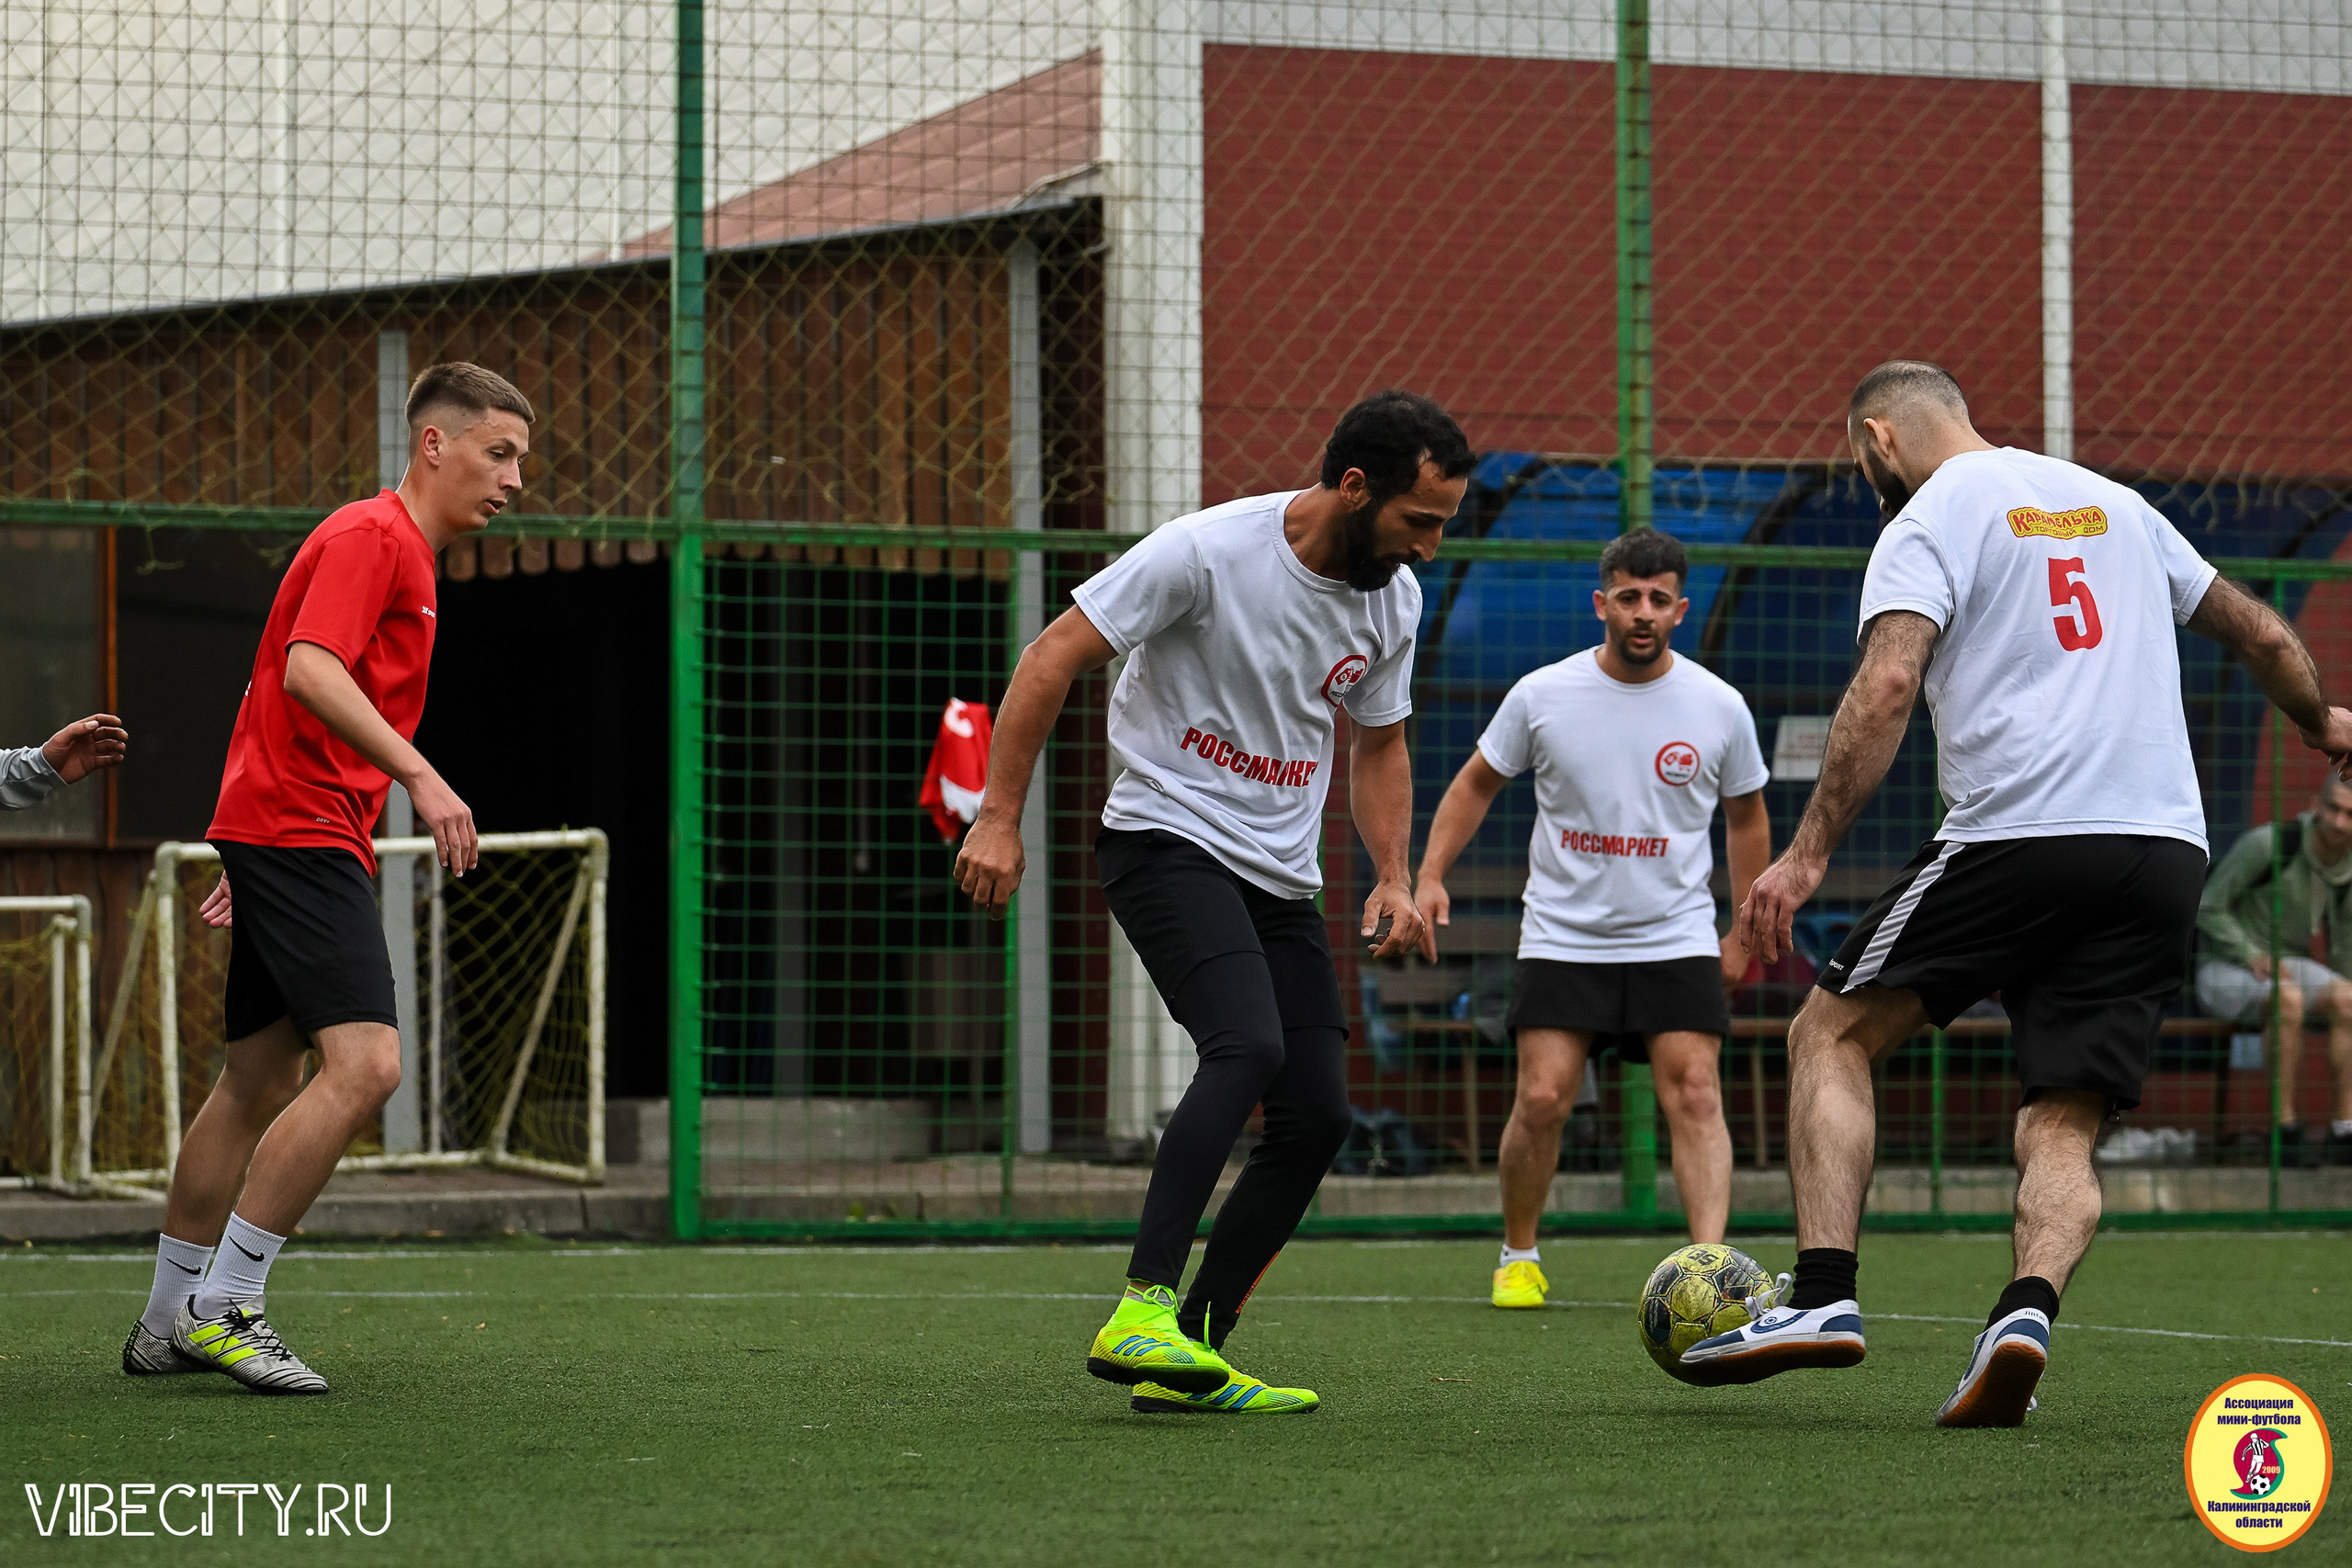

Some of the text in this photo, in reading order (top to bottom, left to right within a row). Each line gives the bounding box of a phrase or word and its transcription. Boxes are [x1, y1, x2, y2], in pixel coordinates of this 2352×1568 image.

[2012, 511, 2102, 532] КАРАМЕЛЬКА
[2034, 525, 2104, 536] ТОРГОВЫЙ ДОМ
[2048, 557, 2103, 651] 5
[1560, 829, 1669, 856] РОССМАРКЕТ
